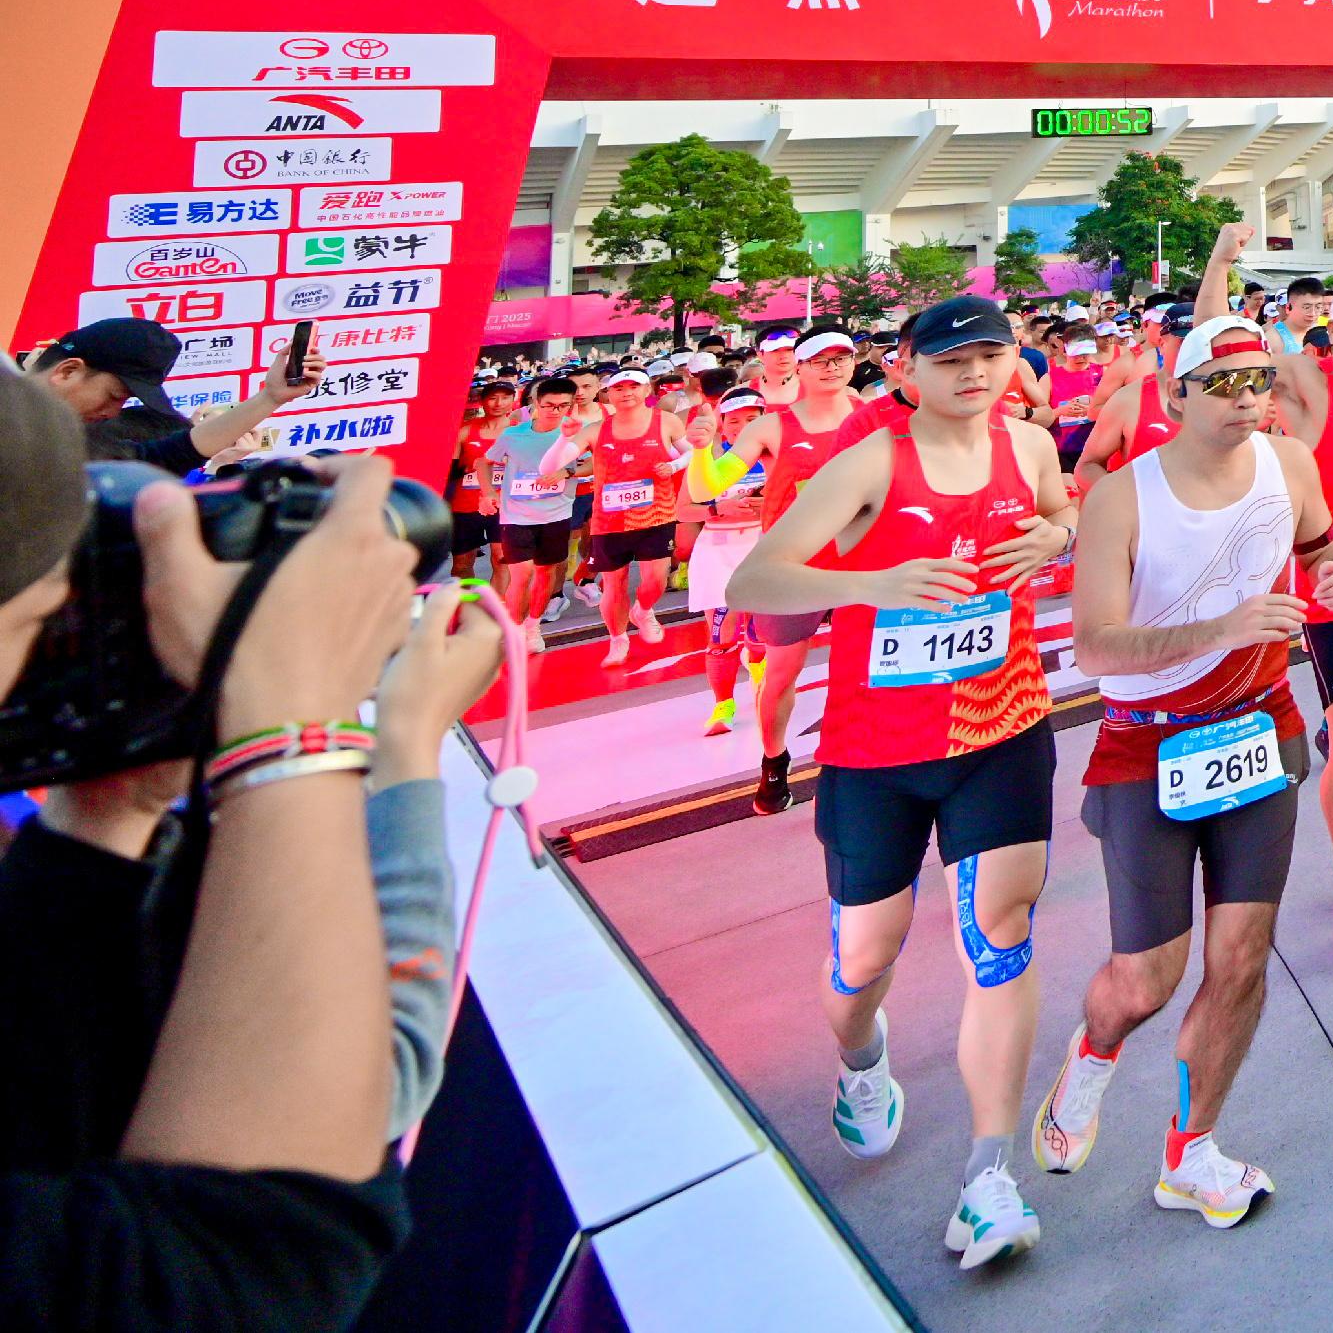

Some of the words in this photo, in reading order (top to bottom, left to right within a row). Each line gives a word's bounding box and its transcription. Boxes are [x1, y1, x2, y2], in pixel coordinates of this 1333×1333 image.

[1067, 1, 1164, 19] Marathon
[252, 66, 411, 81] 广汽丰田
[265, 115, 326, 132] ANTA
[1036, 109, 1152, 135] 00:00:52
[277, 170, 311, 178] BANK
[314, 169, 330, 177] OF
[332, 167, 371, 176] CHINA
[319, 191, 385, 210] 爱跑
[186, 198, 279, 224] 易方达
[150, 246, 215, 262] 百岁山
[353, 234, 429, 260] 蒙牛
[134, 257, 237, 279] Ganten
[294, 289, 323, 300] Move
[342, 279, 424, 310] 益节
[126, 290, 225, 326] 立白
[501, 312, 532, 322] 2025
[179, 336, 236, 351] 广场
[331, 325, 418, 348] 康比特
[289, 414, 395, 447] 补水啦
[618, 490, 647, 504] 1981
[882, 638, 899, 656] D
[923, 625, 994, 662] 1143
[1169, 769, 1184, 788] D
[1204, 744, 1268, 791] 2619
